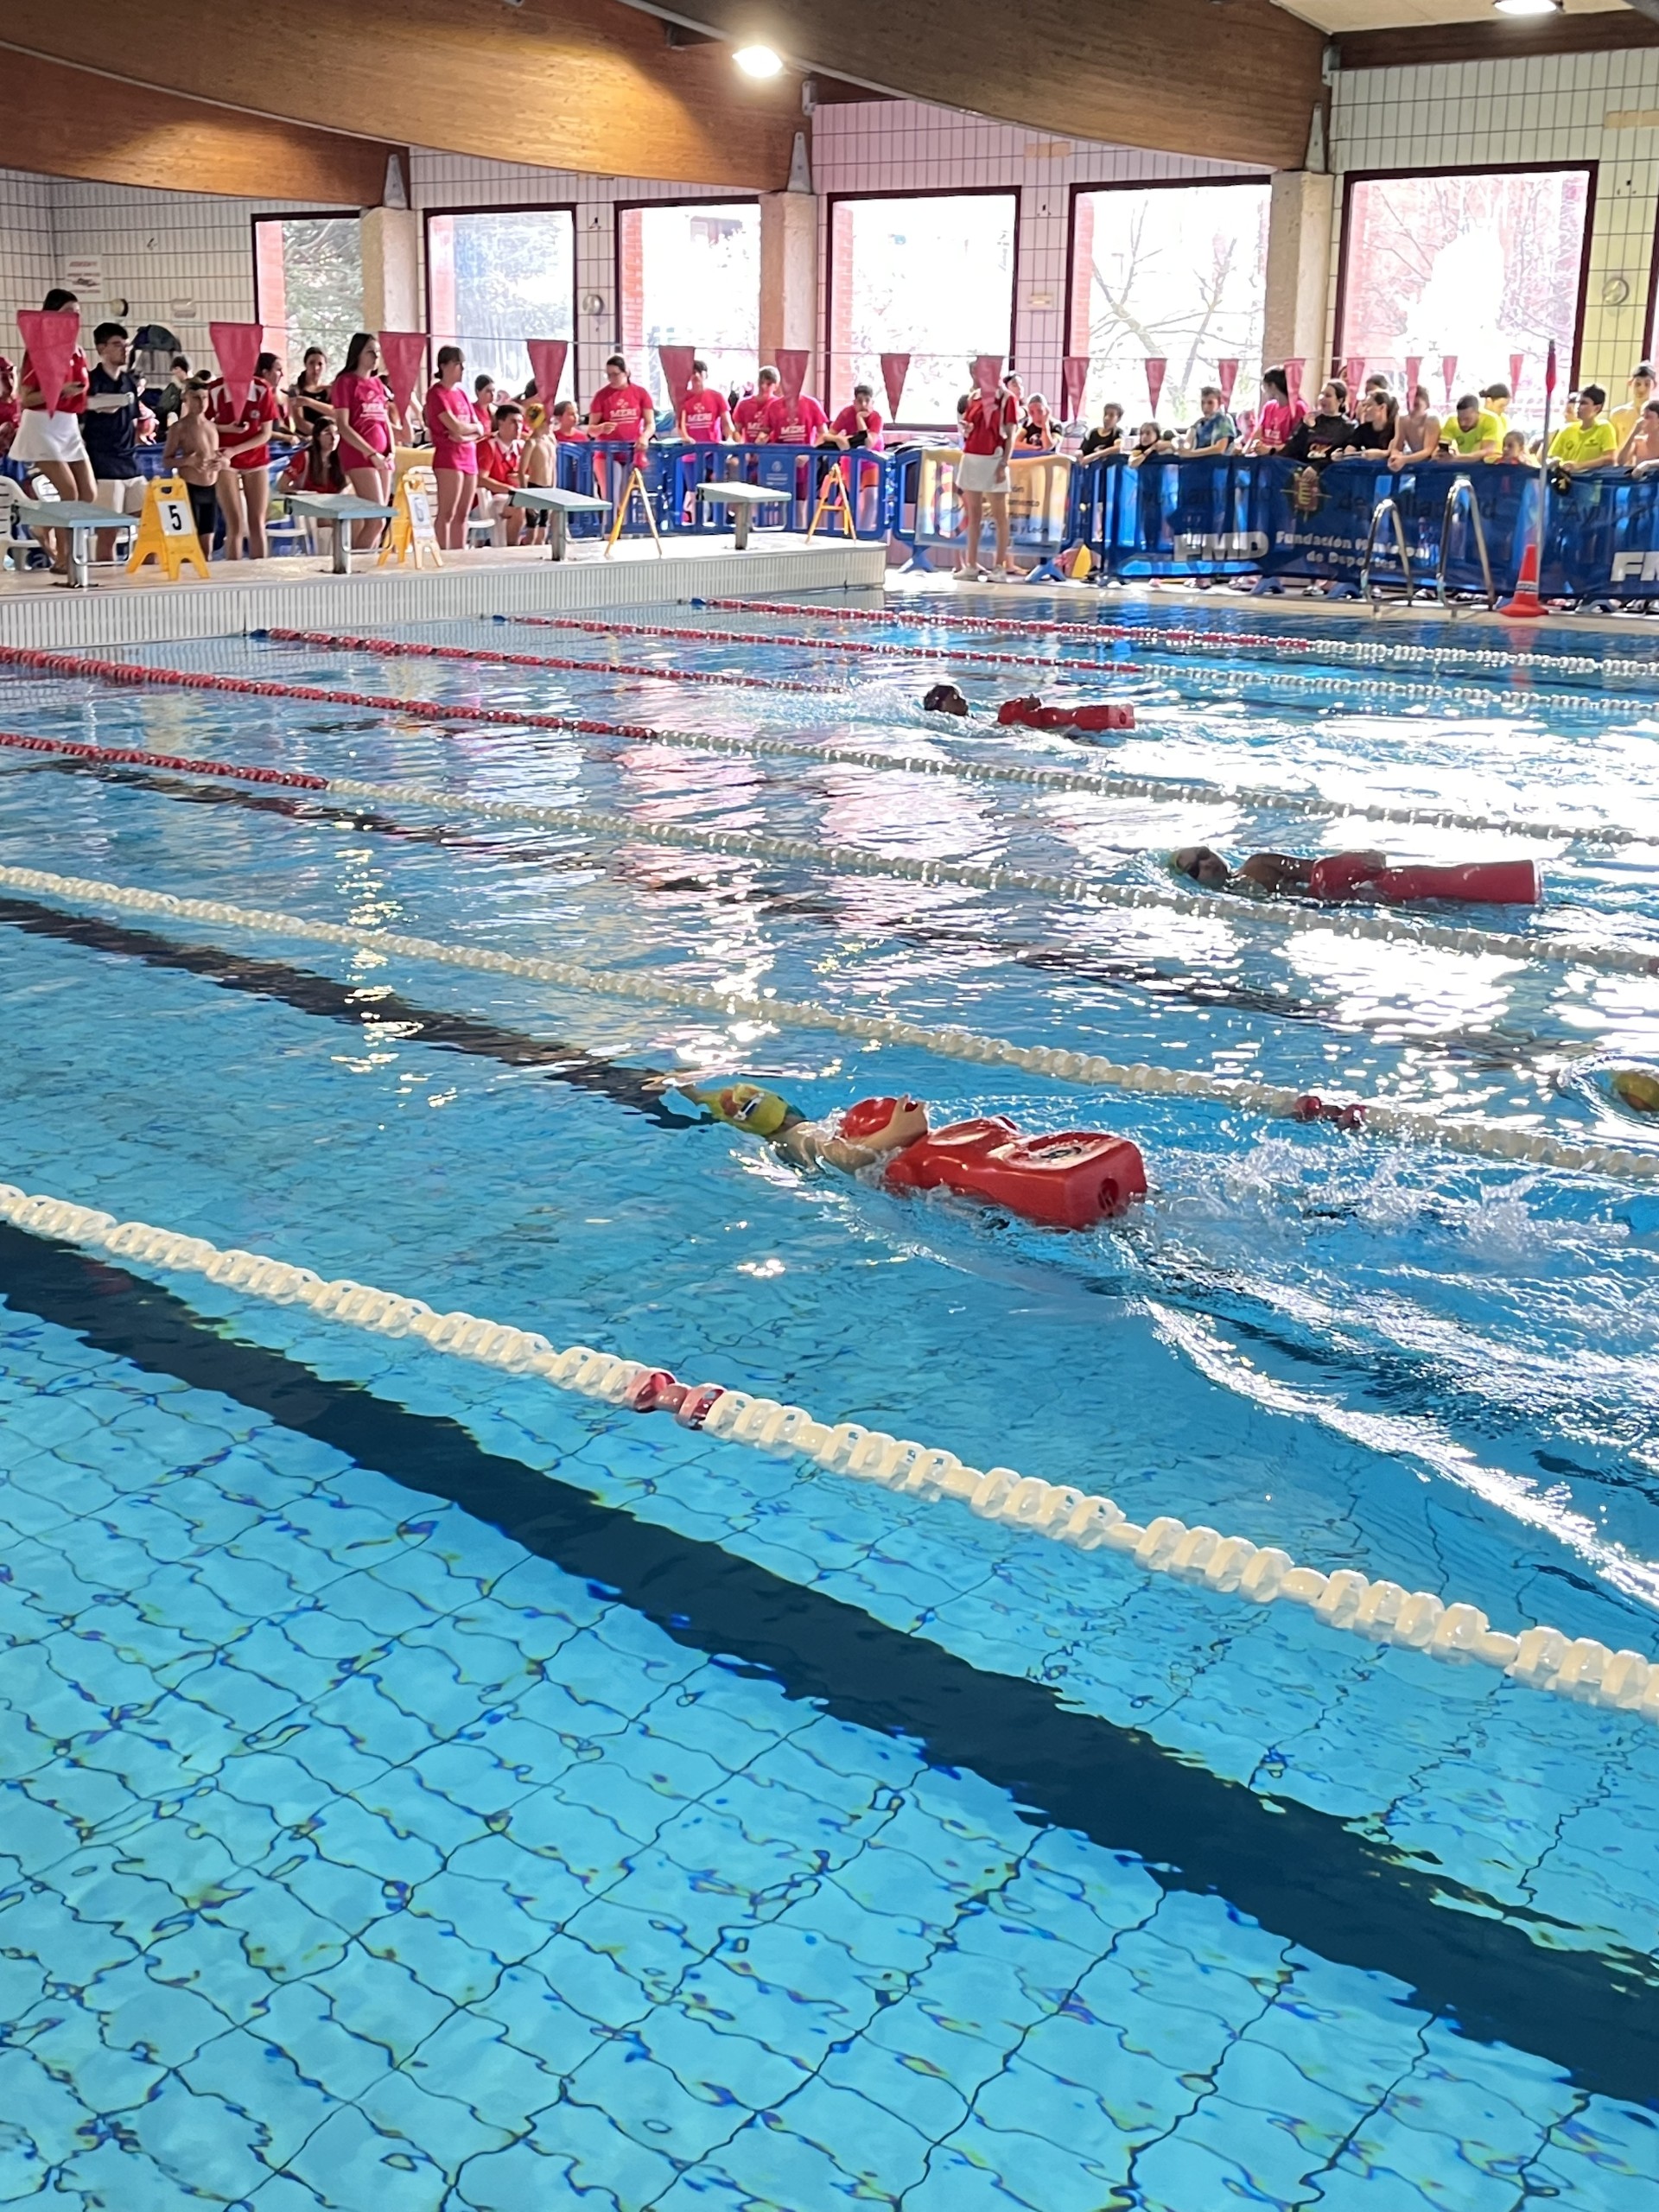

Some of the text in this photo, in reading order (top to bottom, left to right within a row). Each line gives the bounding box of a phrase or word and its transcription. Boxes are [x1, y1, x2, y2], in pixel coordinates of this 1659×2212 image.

[168, 505, 182, 531] 5
[1173, 531, 1268, 562] FMD
[1275, 531, 1430, 559] Fundación Mnicpal
[1306, 550, 1396, 569] de Depotes
